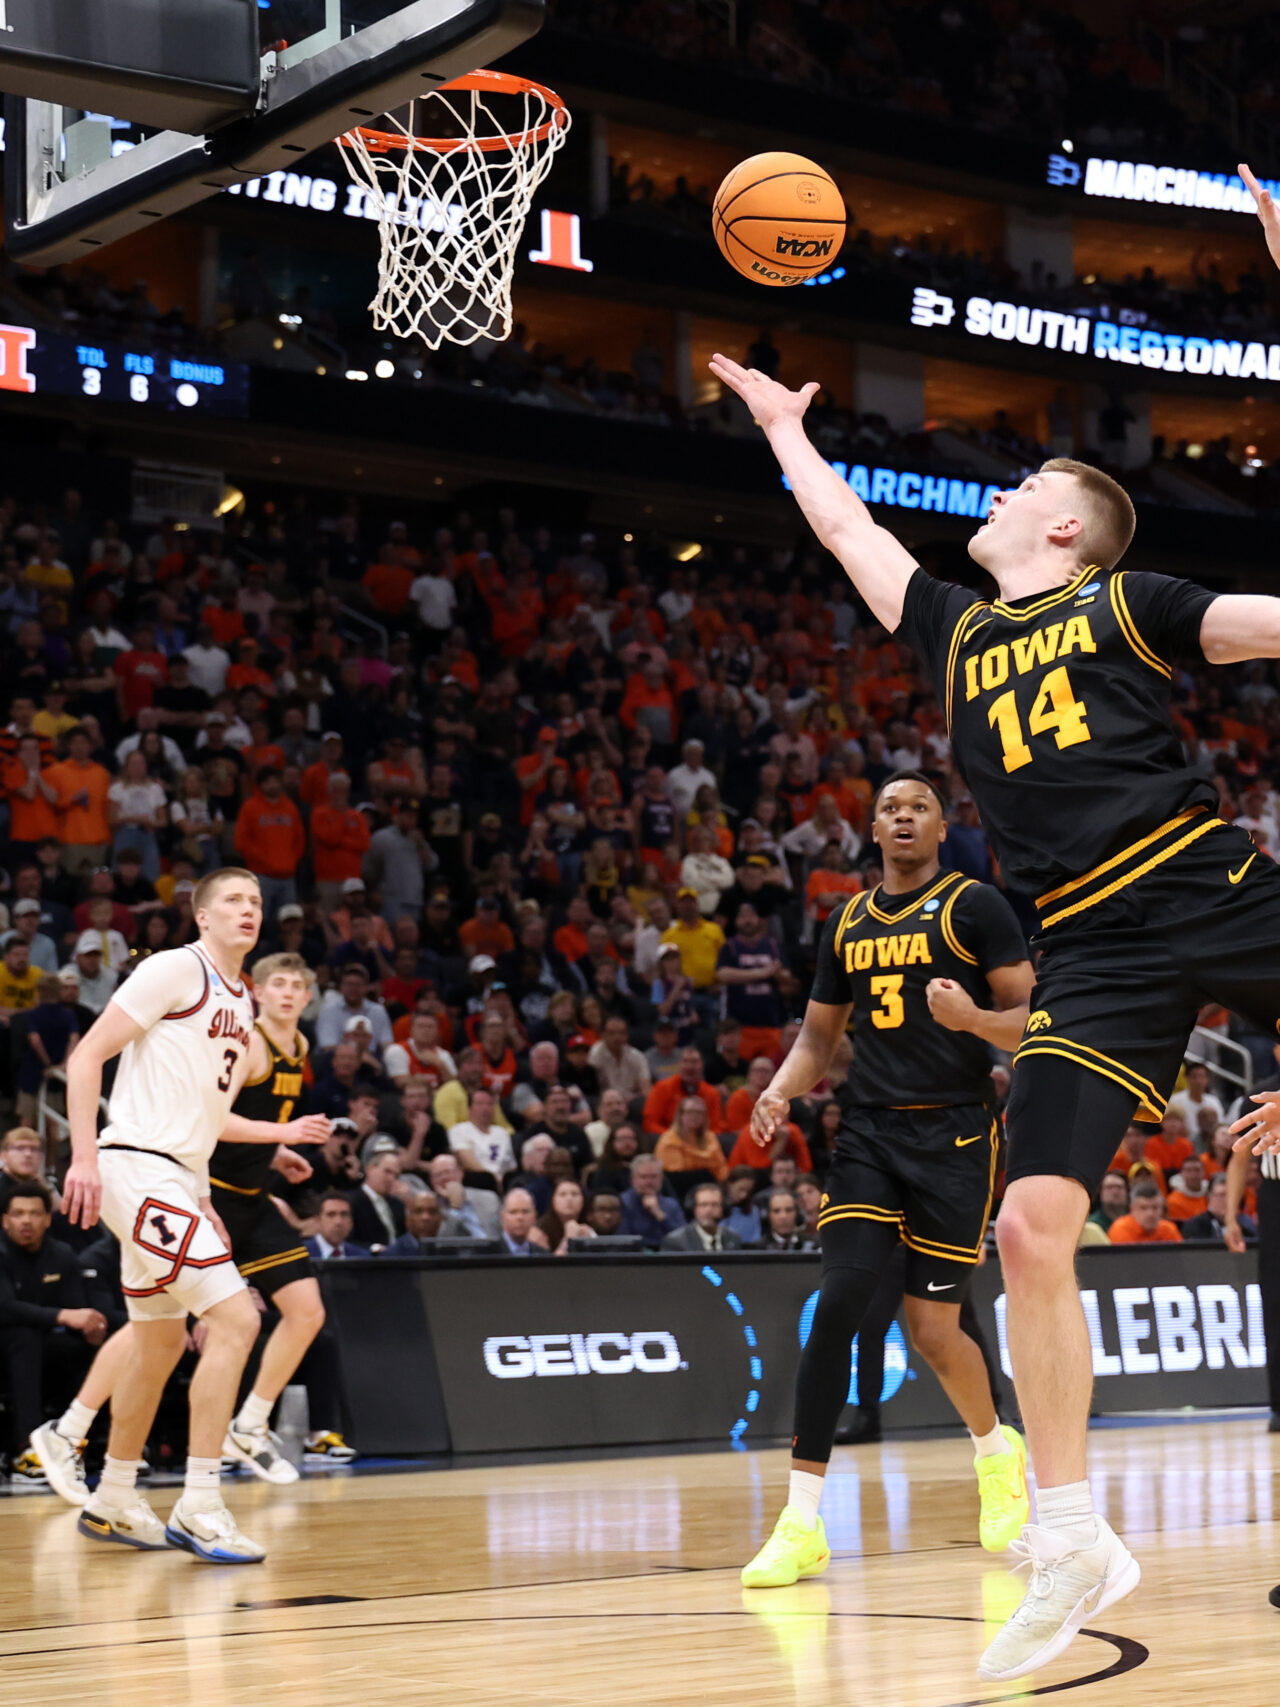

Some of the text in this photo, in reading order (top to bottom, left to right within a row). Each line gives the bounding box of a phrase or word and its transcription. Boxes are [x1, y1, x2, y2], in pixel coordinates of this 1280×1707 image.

[776, 236, 834, 257] NCAA
[965, 297, 1090, 354] SOUTH
[82, 367, 149, 402] 3 6
[170, 360, 225, 386] BONUS
[965, 615, 1097, 702] IOWA
[987, 665, 1092, 774] 14
[845, 932, 933, 974] IOWA
[870, 974, 905, 1029] 3
[218, 1048, 238, 1092] 3
[483, 1331, 680, 1379] GEICO
